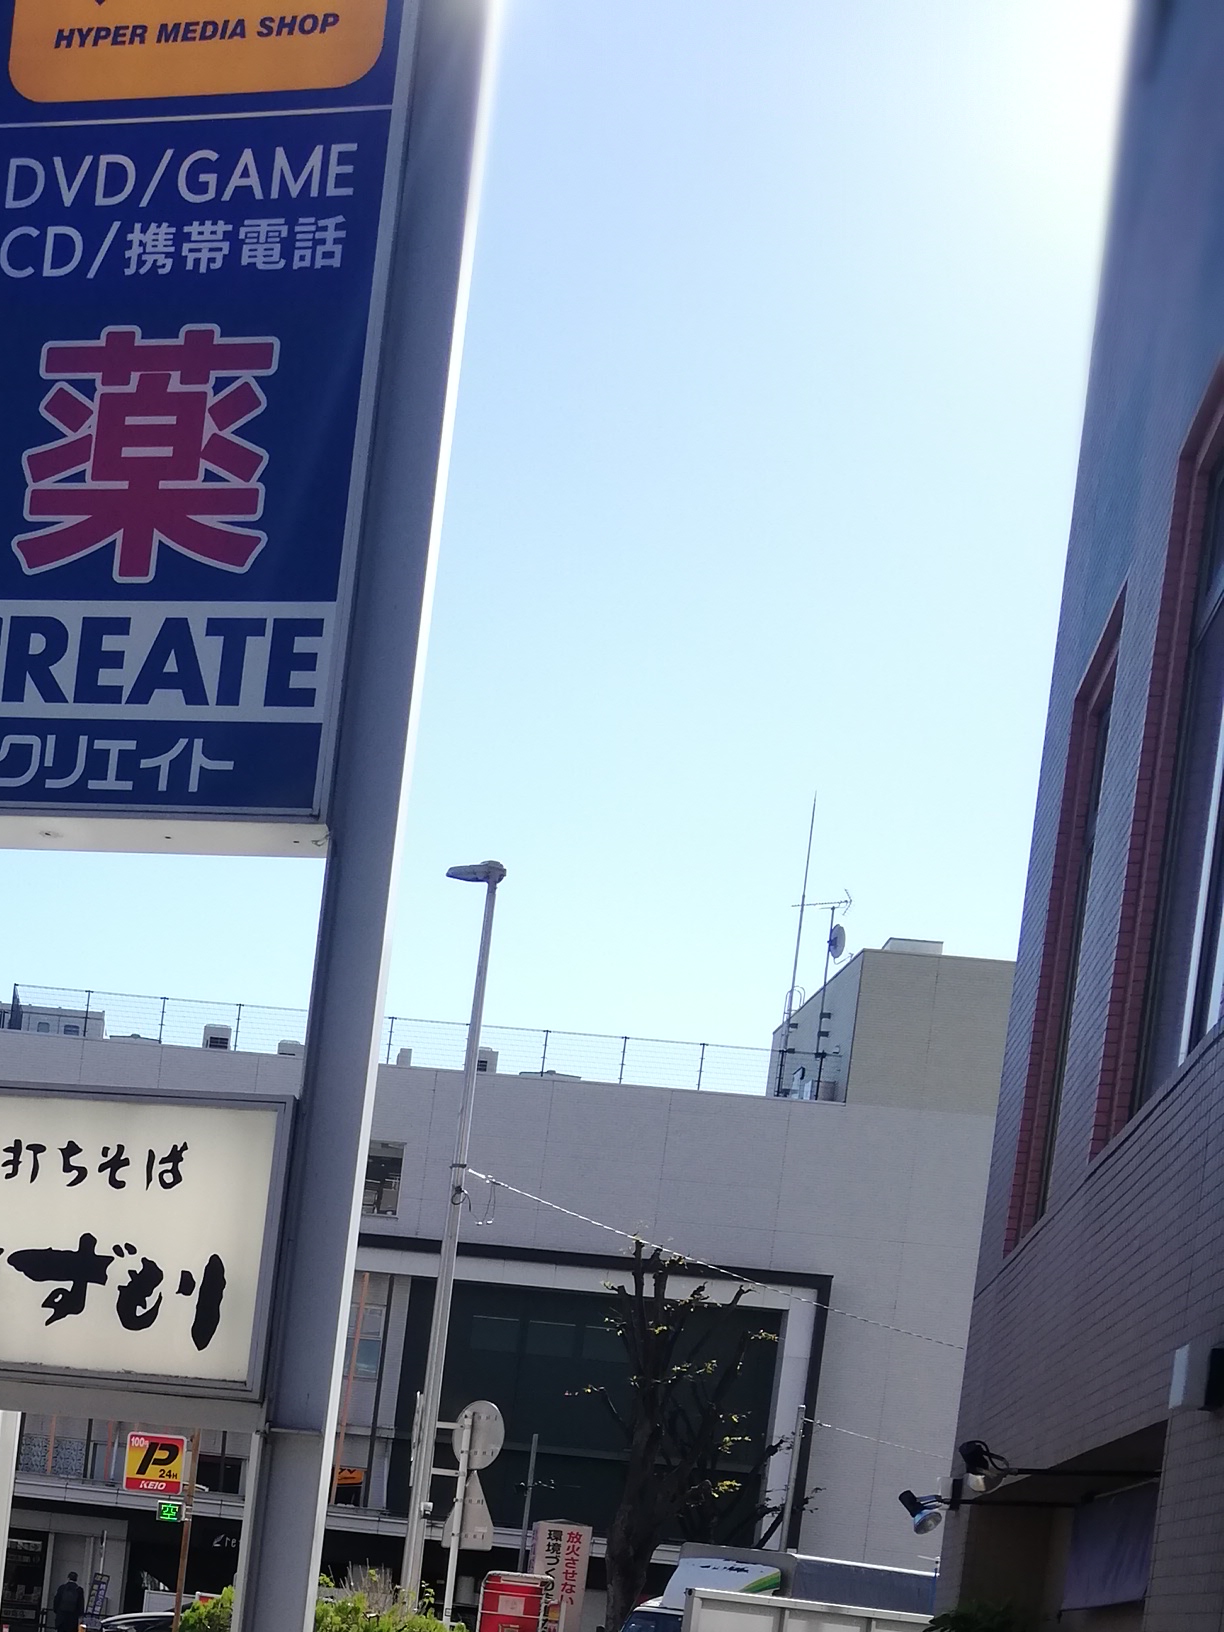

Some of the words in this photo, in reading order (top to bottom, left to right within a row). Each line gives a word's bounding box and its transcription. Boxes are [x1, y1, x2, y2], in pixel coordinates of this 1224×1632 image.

[54, 23, 148, 49] HYPER
[156, 18, 246, 44] MEDIA
[257, 12, 340, 38] SHOP
[4, 142, 358, 210] DVD/GAME
[12, 323, 280, 584] 薬
[136, 1441, 180, 1476] P
[158, 1469, 178, 1480] 24H
[139, 1480, 167, 1490] KEIO
[159, 1503, 179, 1521] 空
[560, 1530, 583, 1607] 放火させない
